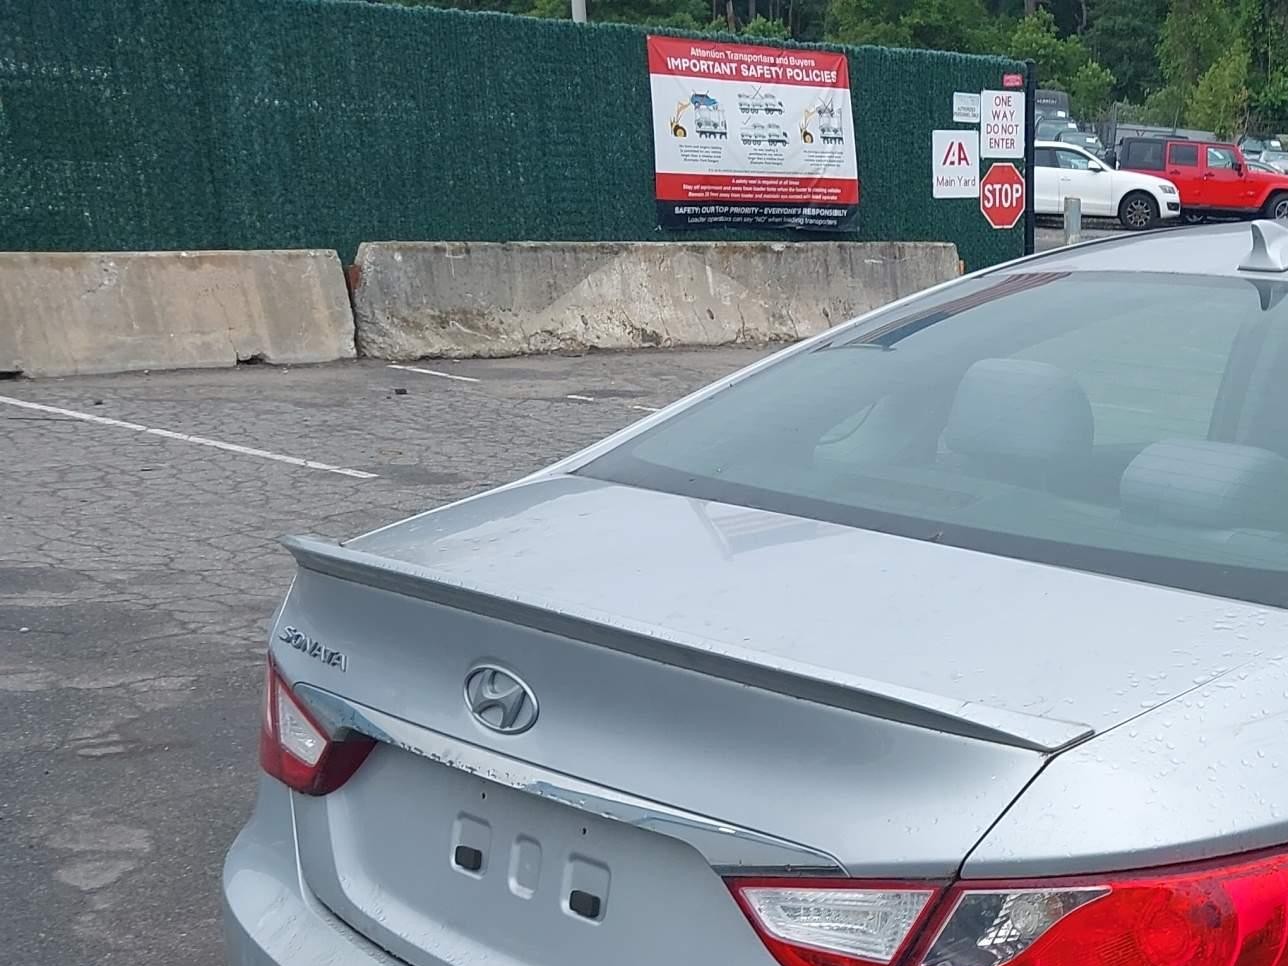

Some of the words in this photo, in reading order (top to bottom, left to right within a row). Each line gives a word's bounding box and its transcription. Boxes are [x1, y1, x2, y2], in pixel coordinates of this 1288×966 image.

[690, 47, 725, 59] Attention
[725, 50, 774, 63] Transporters
[776, 56, 788, 65] and
[790, 57, 815, 67] Buyers
[667, 57, 737, 75] IMPORTANT
[741, 64, 783, 79] SAFETY
[786, 67, 837, 83] POLICIES
[994, 95, 1012, 107] ONE
[991, 110, 1016, 121] WAY
[986, 124, 1000, 135] DO
[1001, 124, 1020, 136] NOT
[989, 138, 1015, 149] ENTER
[936, 176, 956, 187] Main
[957, 176, 976, 187] Yard
[983, 183, 1022, 208] STOP
[279, 625, 349, 672] SONATA
